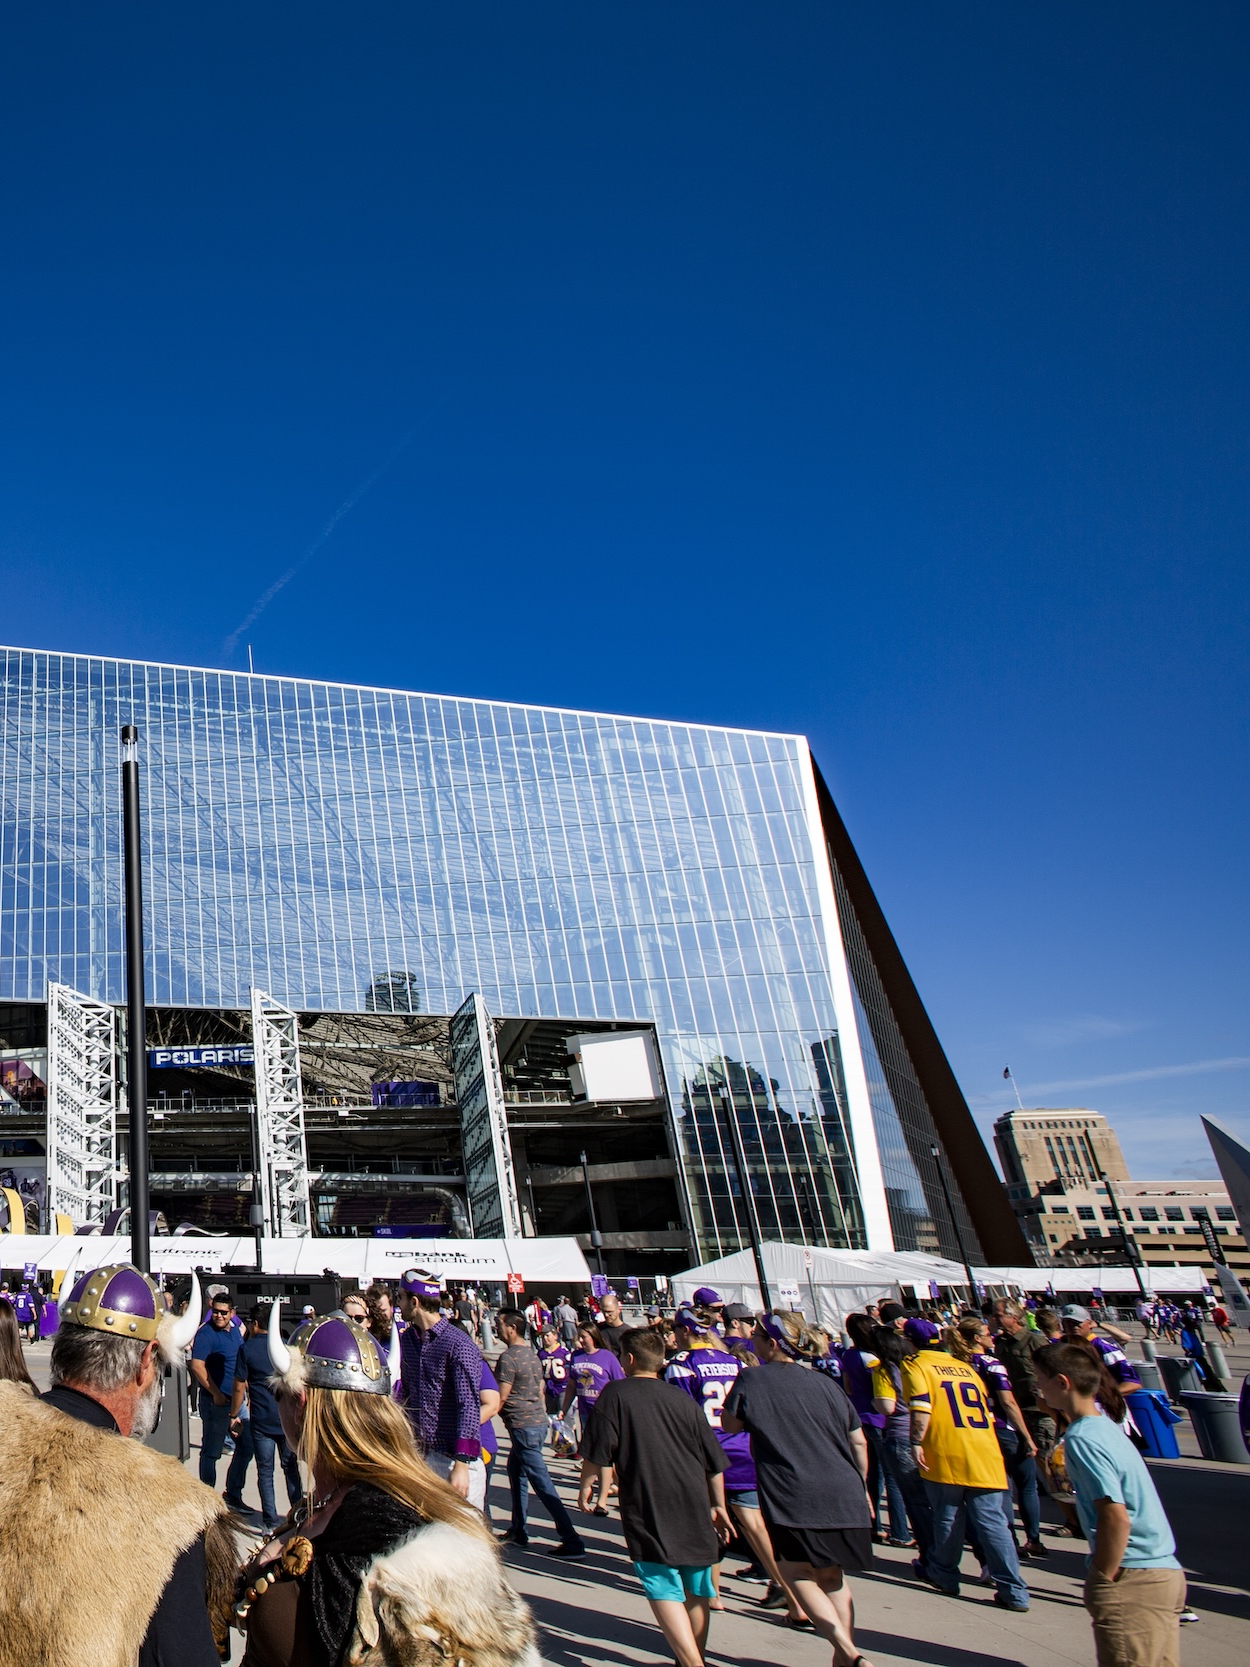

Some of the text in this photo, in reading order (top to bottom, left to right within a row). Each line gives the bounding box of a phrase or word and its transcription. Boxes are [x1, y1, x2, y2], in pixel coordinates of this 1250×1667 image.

[155, 1049, 254, 1065] POLARIS
[414, 1256, 496, 1264] stadium
[18, 1298, 25, 1308] 8
[542, 1358, 566, 1379] 76
[697, 1363, 739, 1377] PETERSON
[932, 1365, 974, 1379] THIELEN
[940, 1380, 990, 1429] 19
